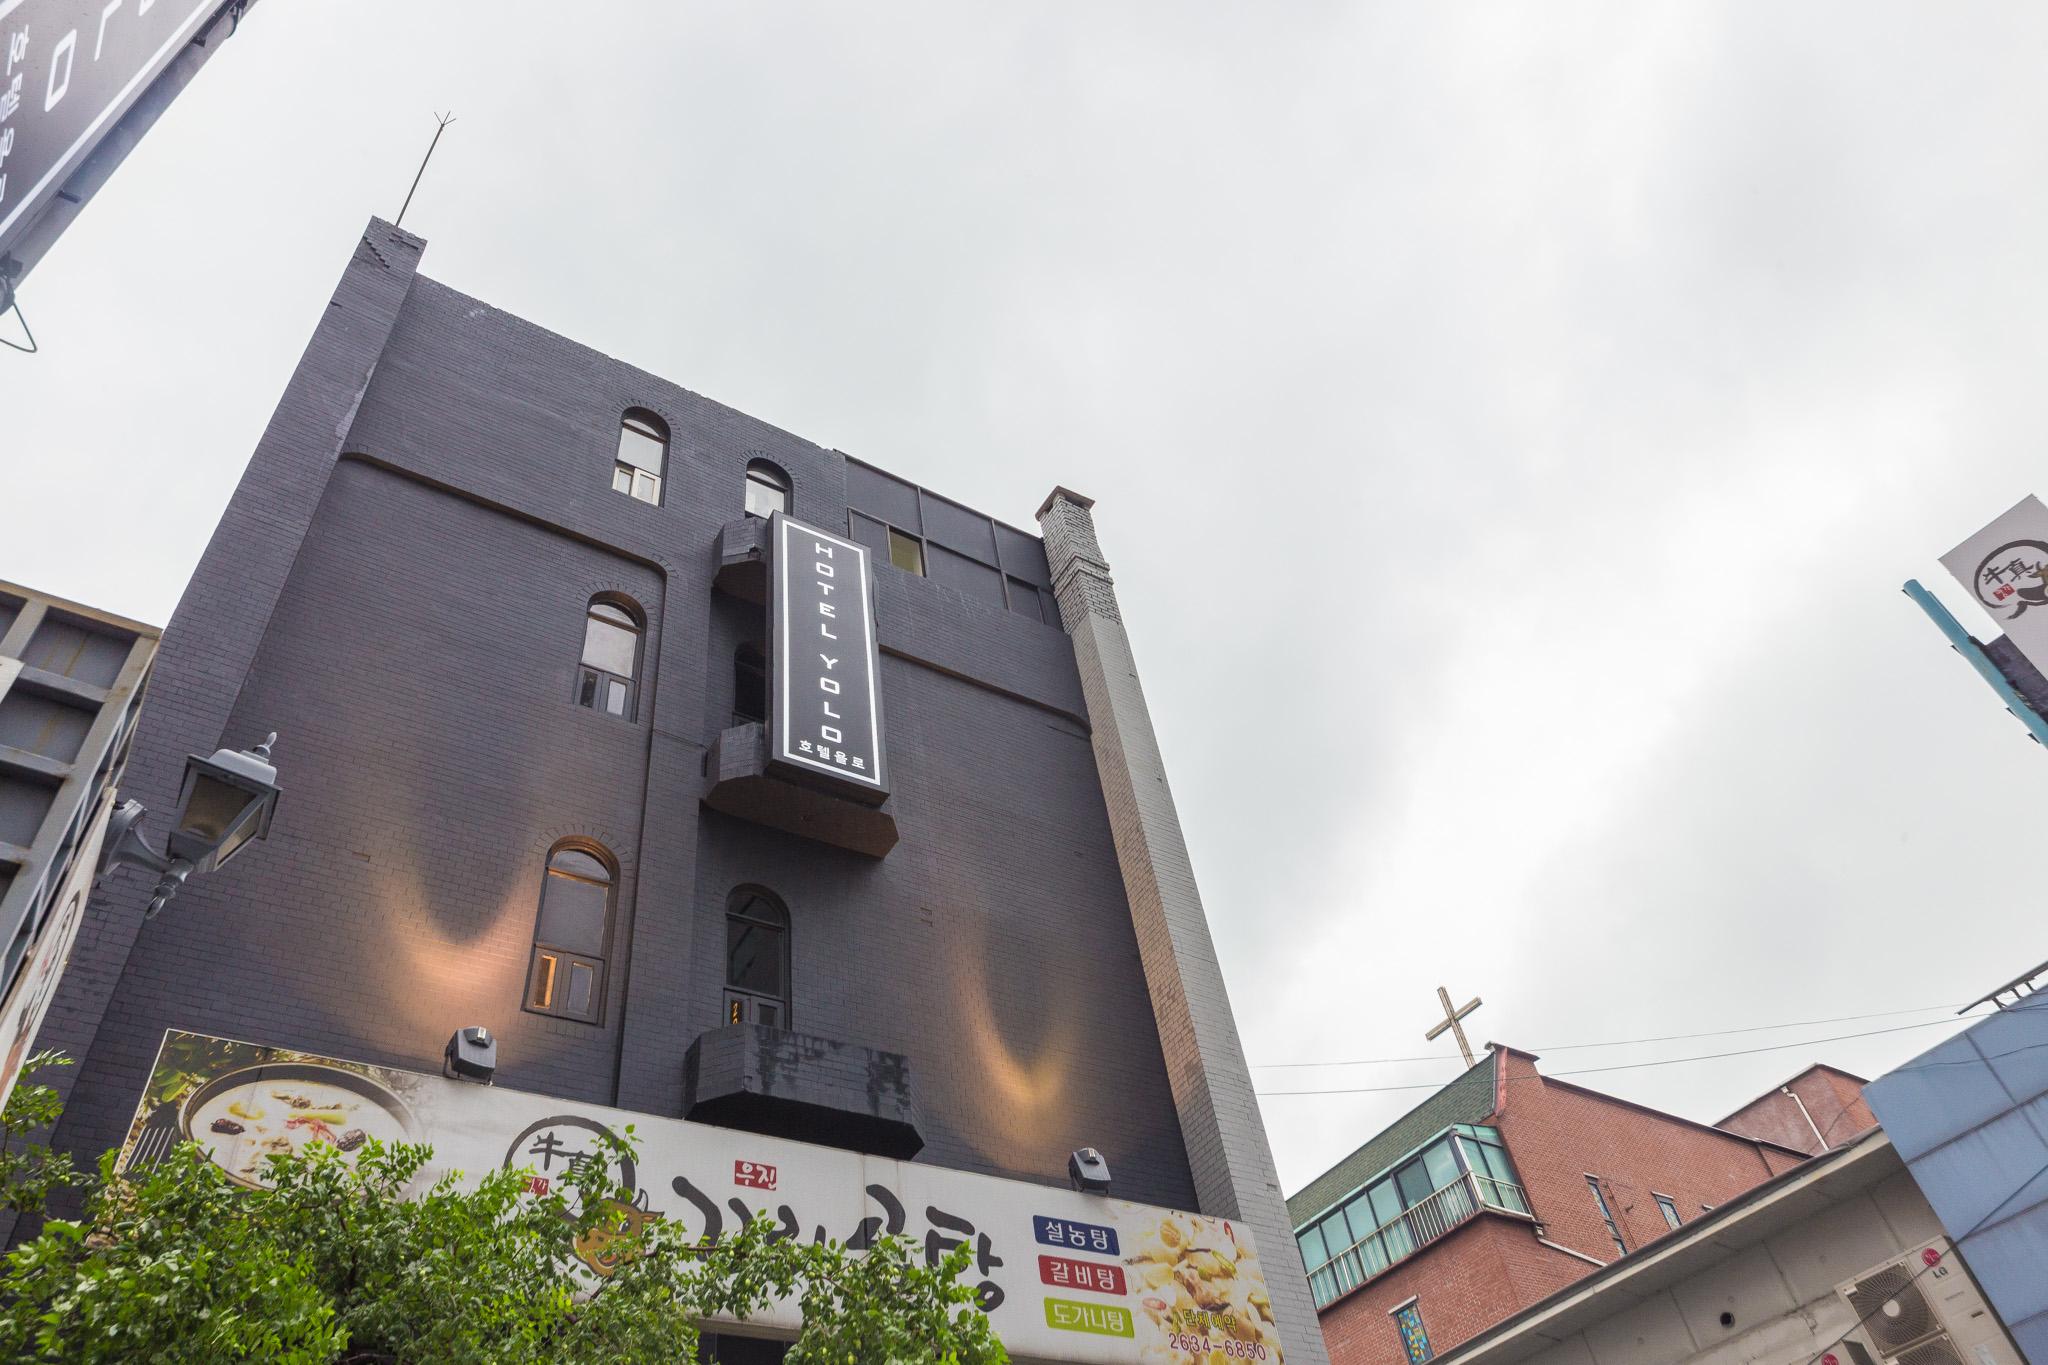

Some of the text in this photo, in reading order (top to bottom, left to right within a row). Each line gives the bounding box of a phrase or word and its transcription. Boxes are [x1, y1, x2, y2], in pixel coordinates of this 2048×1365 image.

[815, 542, 842, 744] HOTEL YOLO
[735, 1161, 777, 1191] 우진
[1045, 1220, 1108, 1251] 설농탕
[1050, 1260, 1115, 1291] 갈비탕
[1933, 1266, 1948, 1279] LG
[1053, 1303, 1124, 1332] 도가니탕
[1168, 1333, 1266, 1361] 2634-6850
